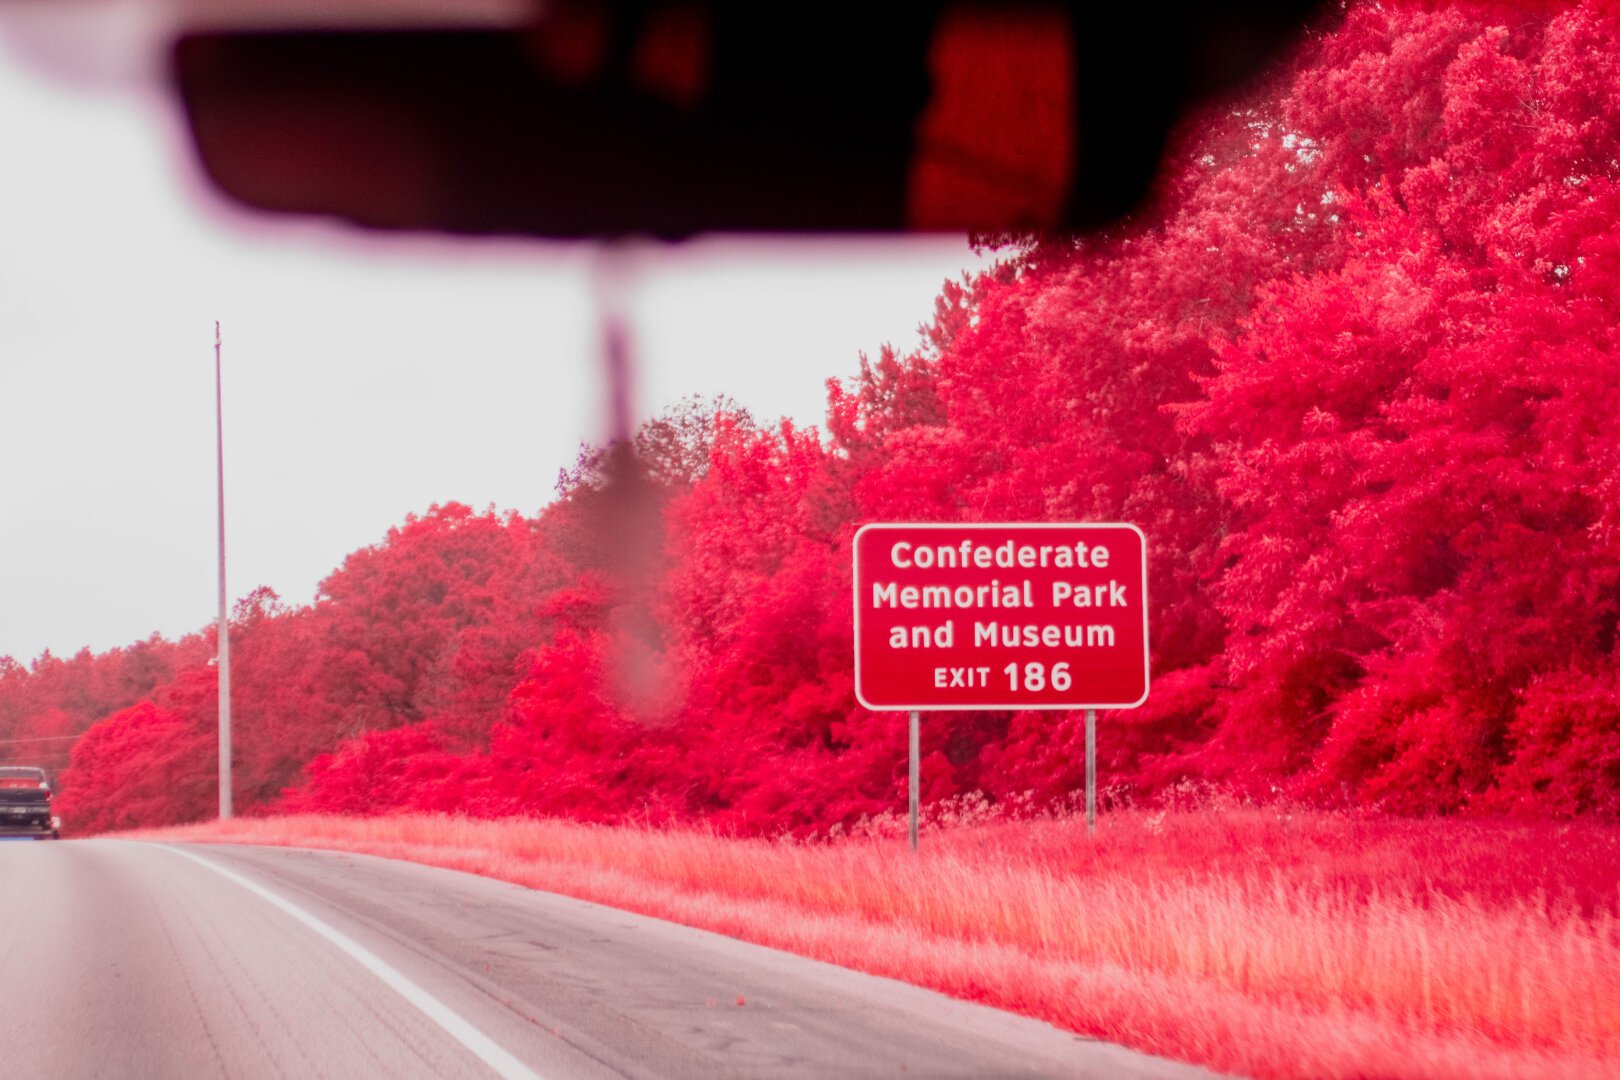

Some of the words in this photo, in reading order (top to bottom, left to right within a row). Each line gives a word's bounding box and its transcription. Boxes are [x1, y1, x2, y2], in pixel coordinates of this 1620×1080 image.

[890, 540, 1110, 568] Confederate
[872, 580, 1033, 608] Memorial
[1052, 580, 1127, 607] Park
[889, 621, 953, 648] and
[974, 621, 1115, 647] Museum
[934, 667, 990, 688] EXIT
[1003, 662, 1072, 691] 186
